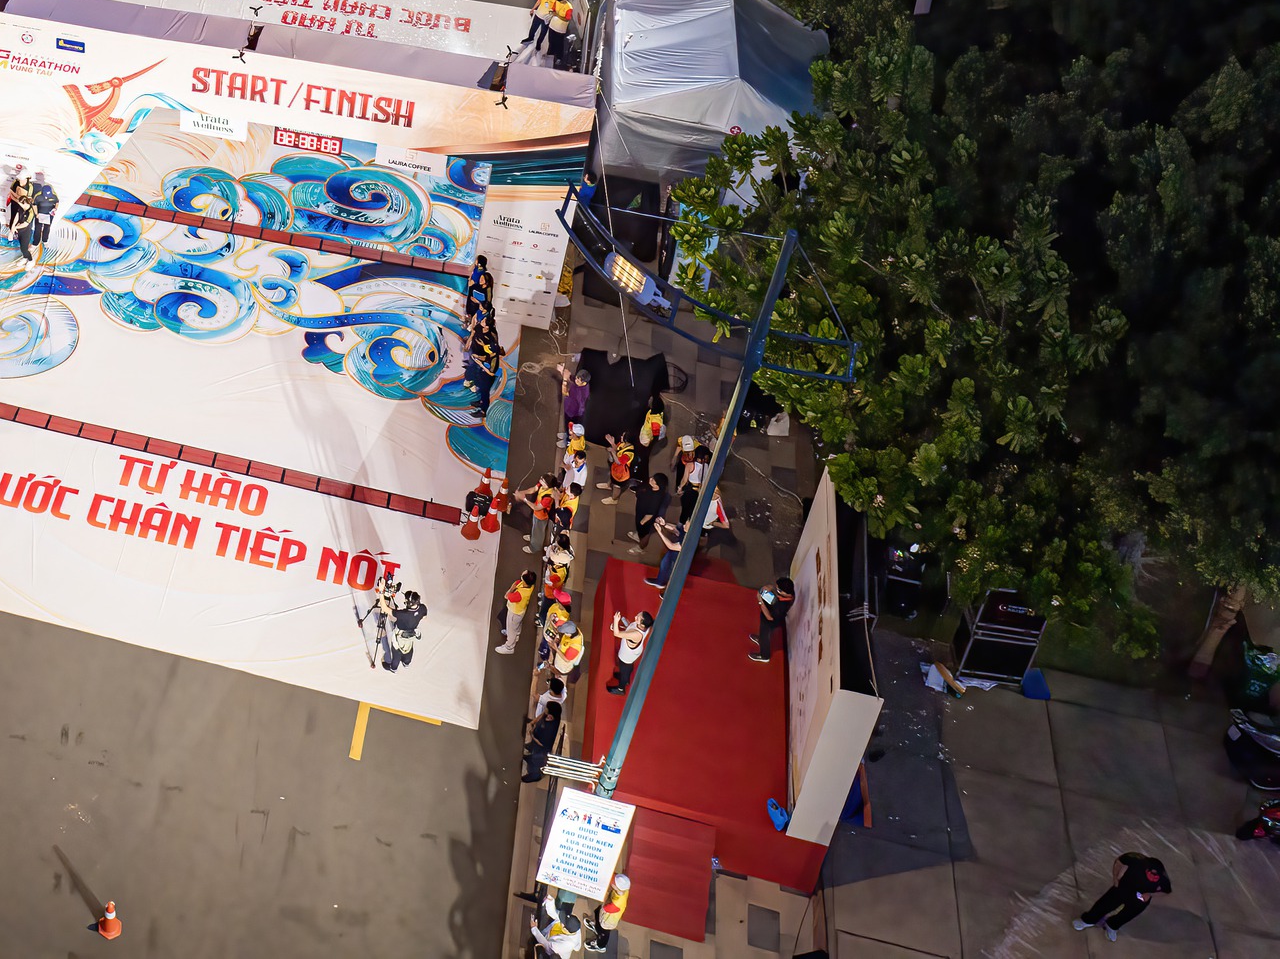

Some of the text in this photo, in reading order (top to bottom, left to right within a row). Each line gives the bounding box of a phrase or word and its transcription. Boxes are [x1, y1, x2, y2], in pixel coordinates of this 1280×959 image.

[11, 55, 81, 74] MARATHON
[118, 454, 269, 517] TỰ HÀO
[86, 492, 202, 550] CHÂN
[215, 521, 308, 572] TIẾP
